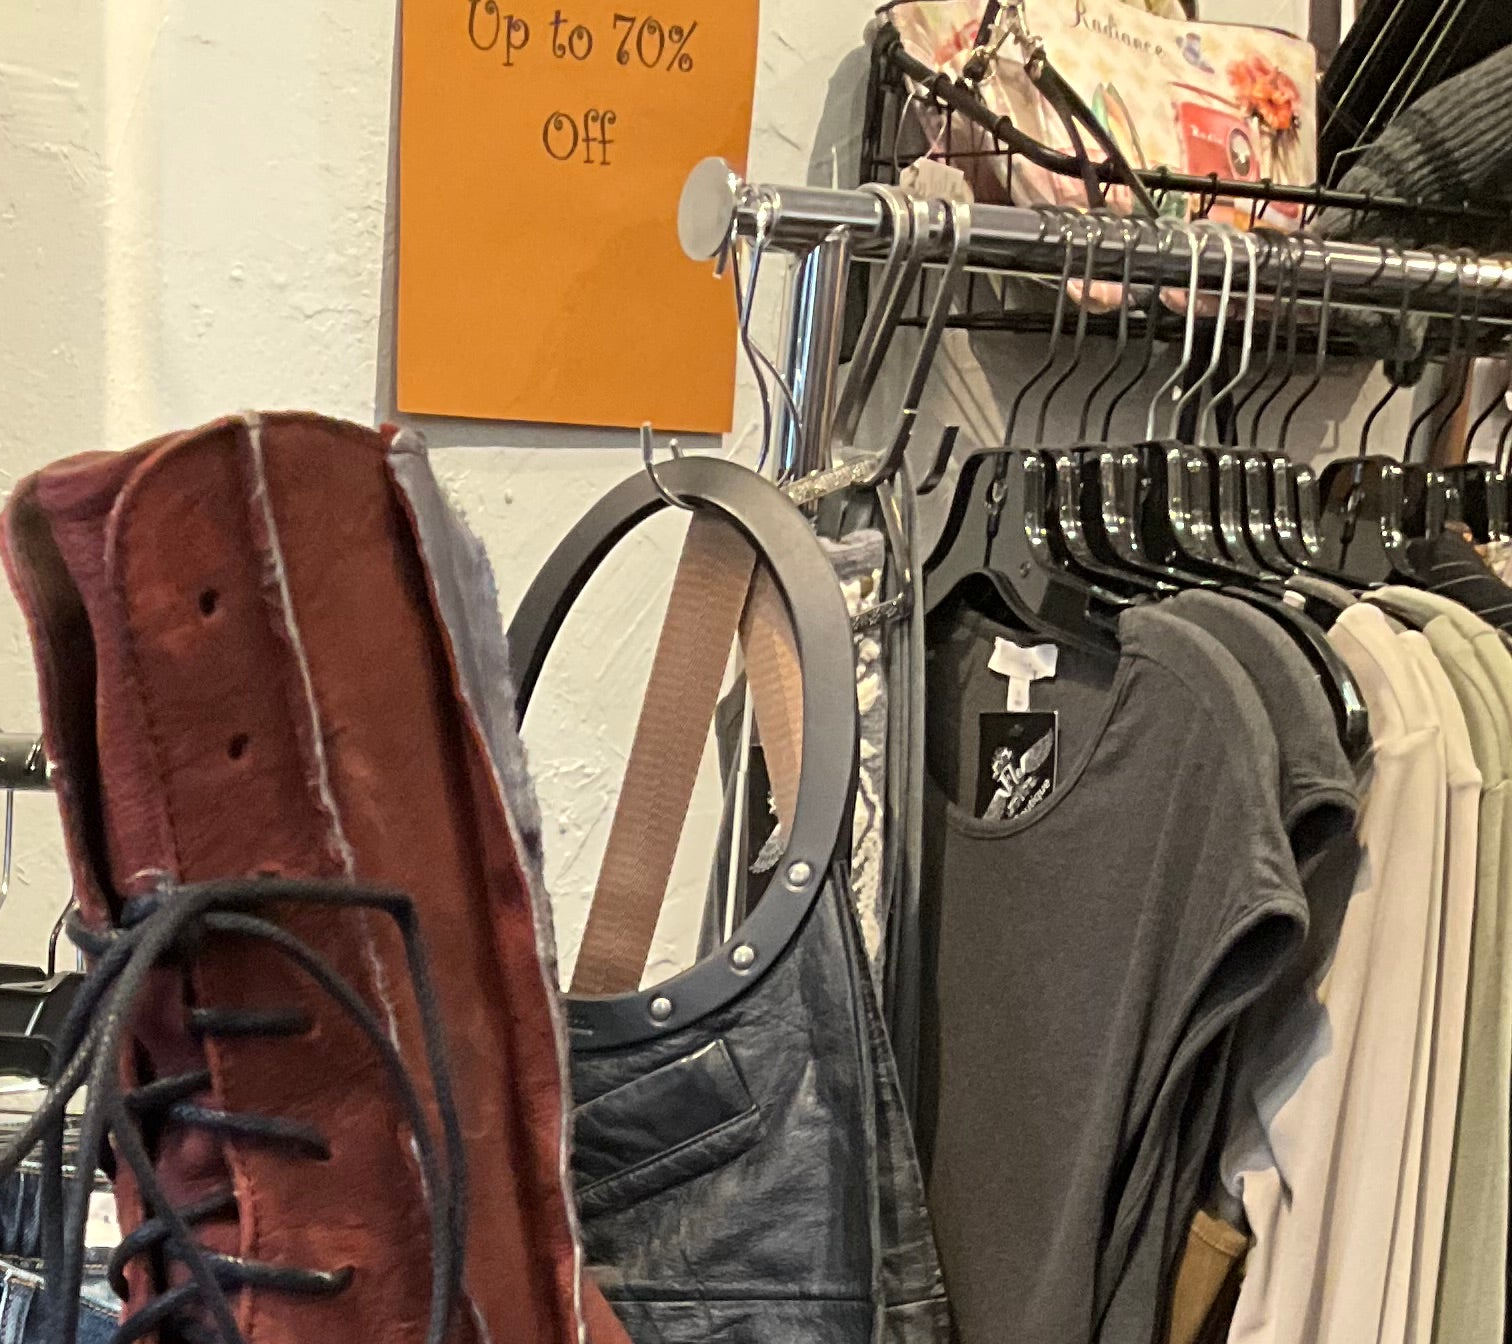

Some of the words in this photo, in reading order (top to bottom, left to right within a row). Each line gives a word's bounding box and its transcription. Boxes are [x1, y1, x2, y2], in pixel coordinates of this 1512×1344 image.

[468, 0, 530, 67] Up
[549, 10, 593, 61] to
[613, 13, 698, 72] 70%
[542, 109, 617, 165] Off
